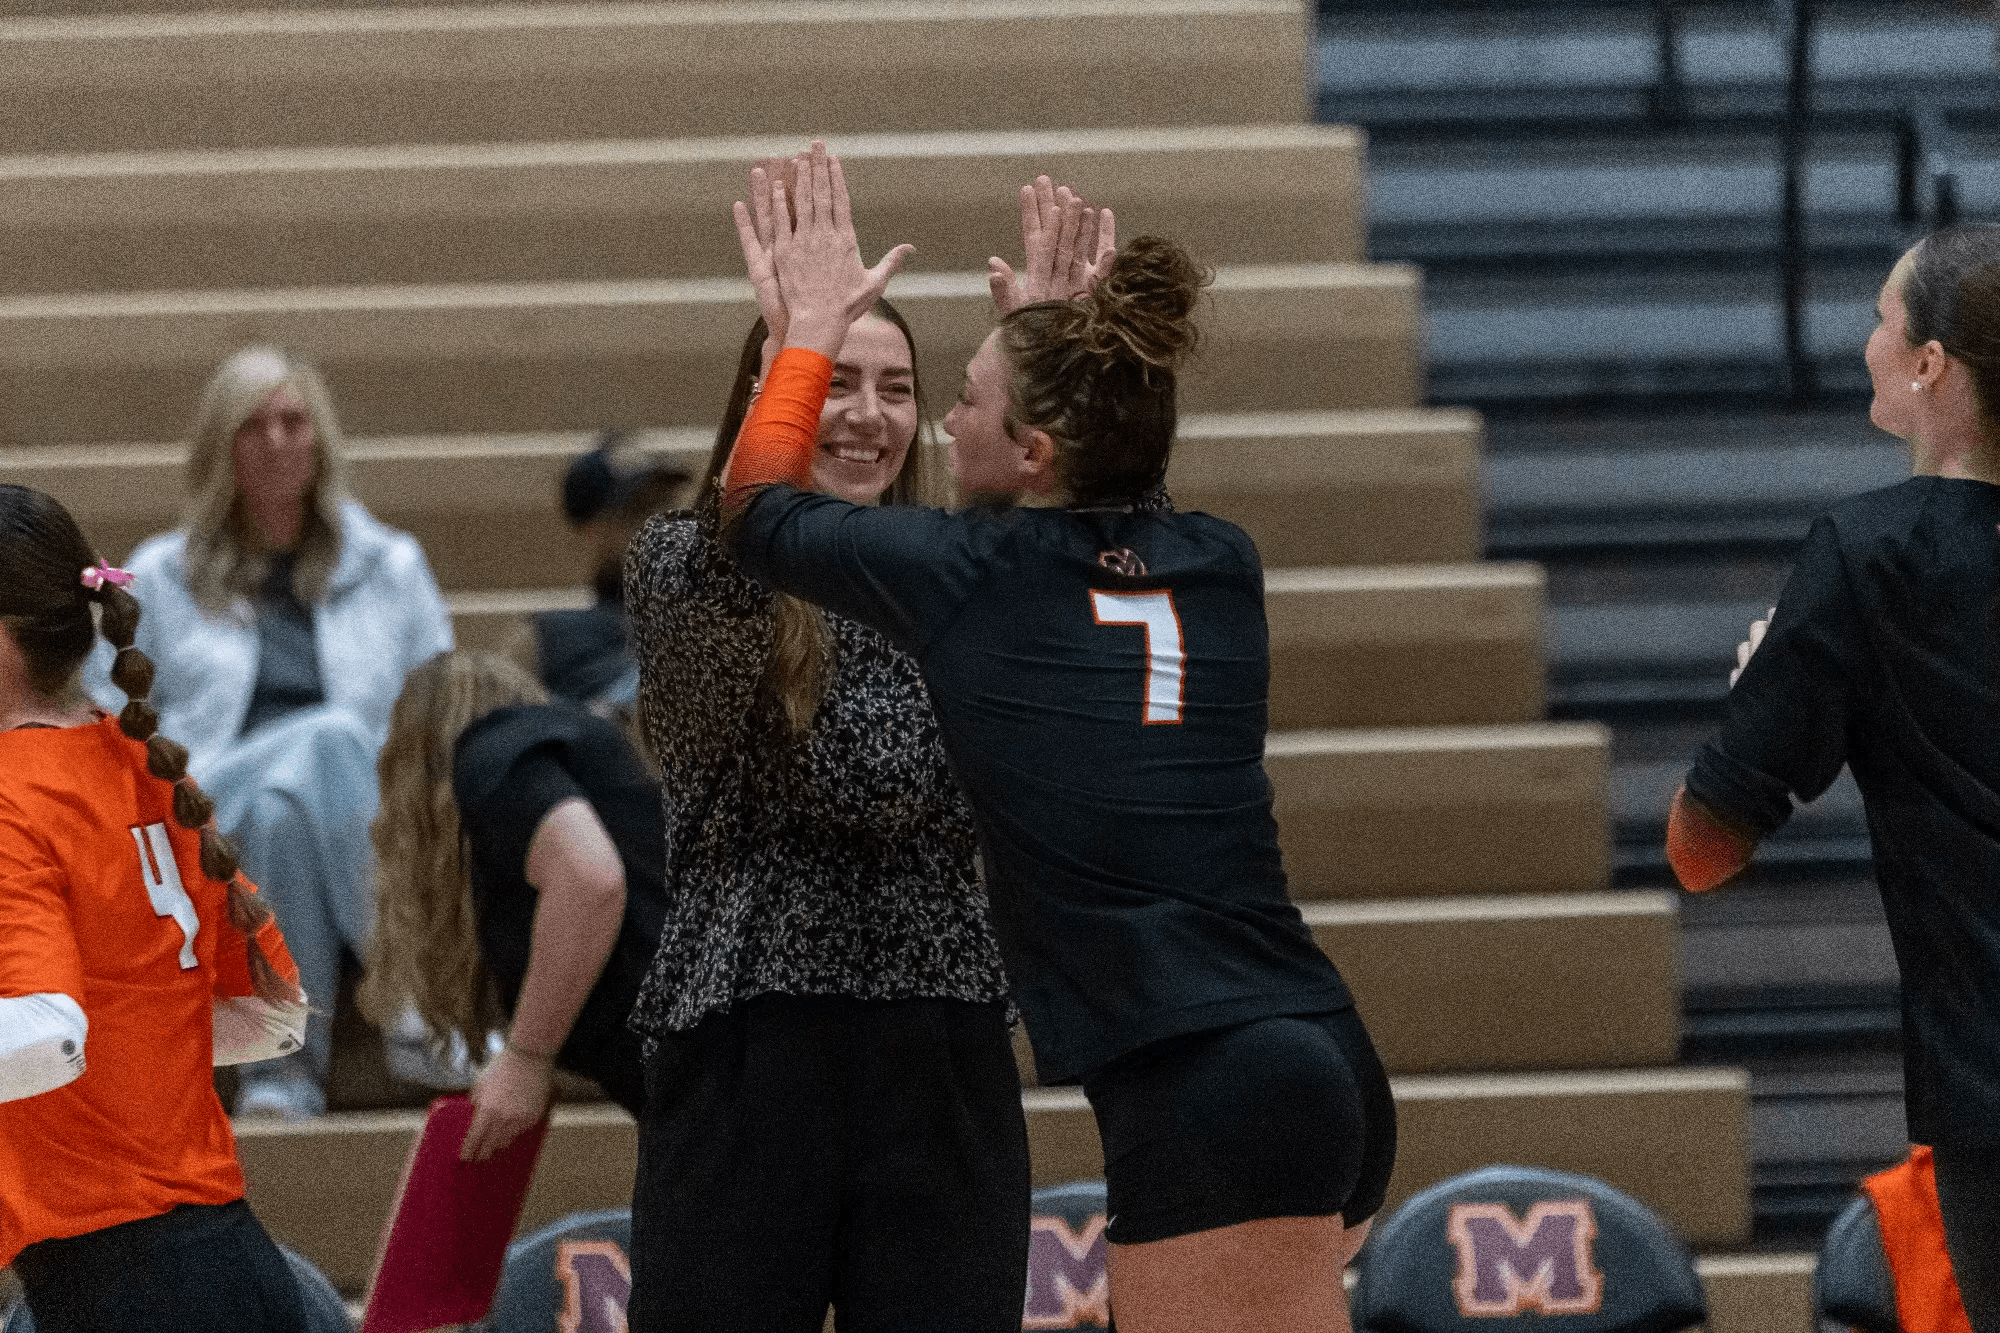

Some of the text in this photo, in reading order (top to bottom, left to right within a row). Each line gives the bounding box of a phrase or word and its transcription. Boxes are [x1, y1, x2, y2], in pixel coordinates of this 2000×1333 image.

[1088, 589, 1187, 725] 7
[129, 821, 200, 971] 4
[1447, 1200, 1603, 1317] M
